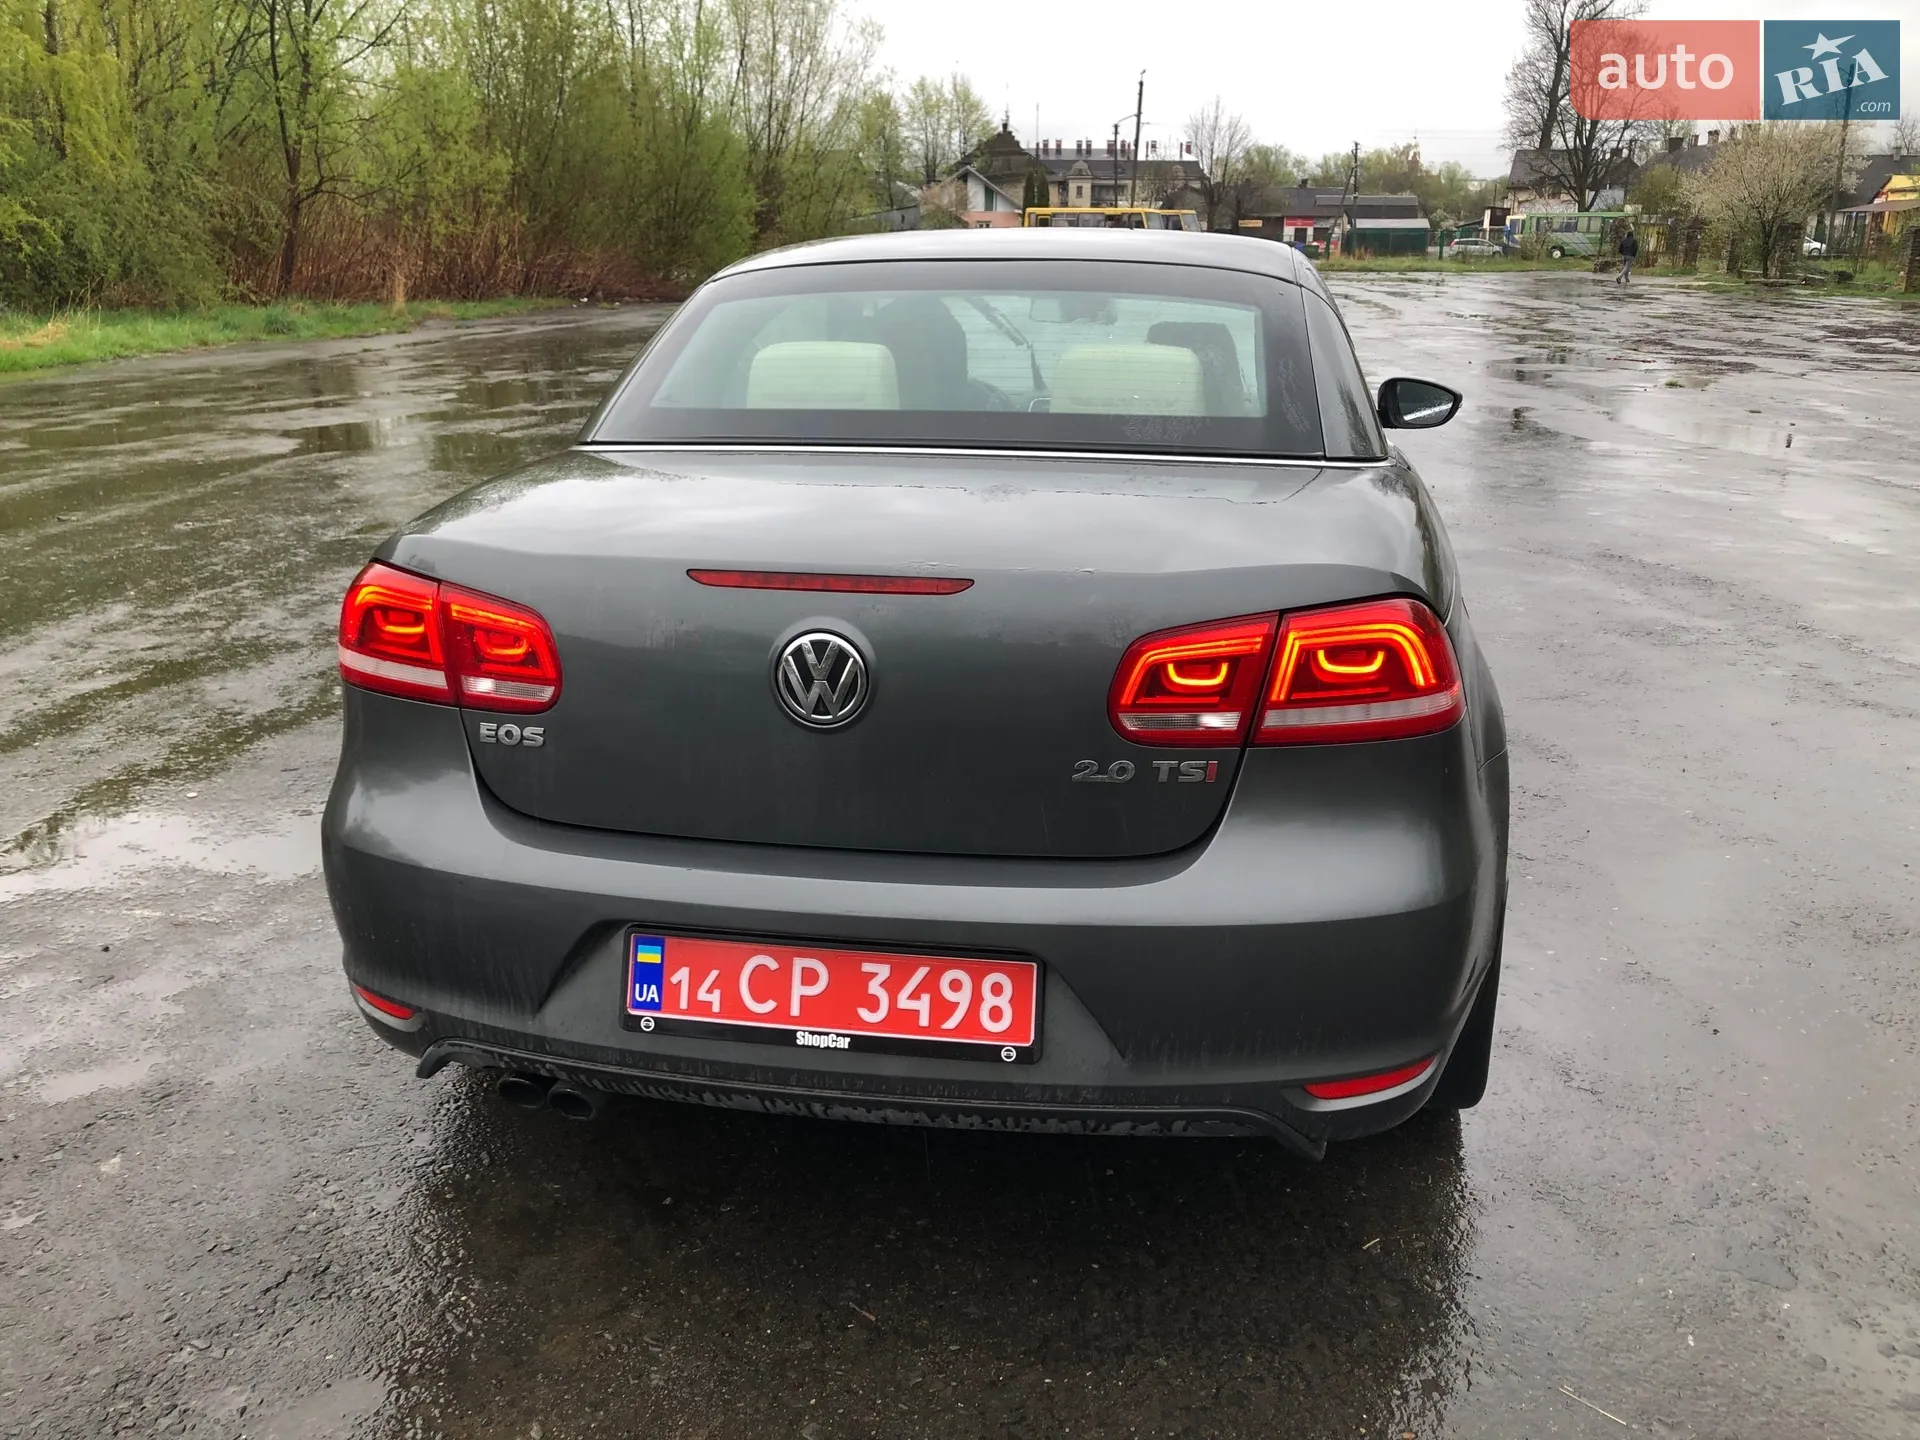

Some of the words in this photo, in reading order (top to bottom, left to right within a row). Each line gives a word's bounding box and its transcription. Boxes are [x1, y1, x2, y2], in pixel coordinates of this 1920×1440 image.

[479, 722, 545, 748] EOS
[634, 983, 660, 1003] UA
[670, 966, 722, 1014] 14
[738, 954, 830, 1018] CP
[856, 962, 1014, 1034] 3498
[796, 1031, 850, 1050] ShopCar
